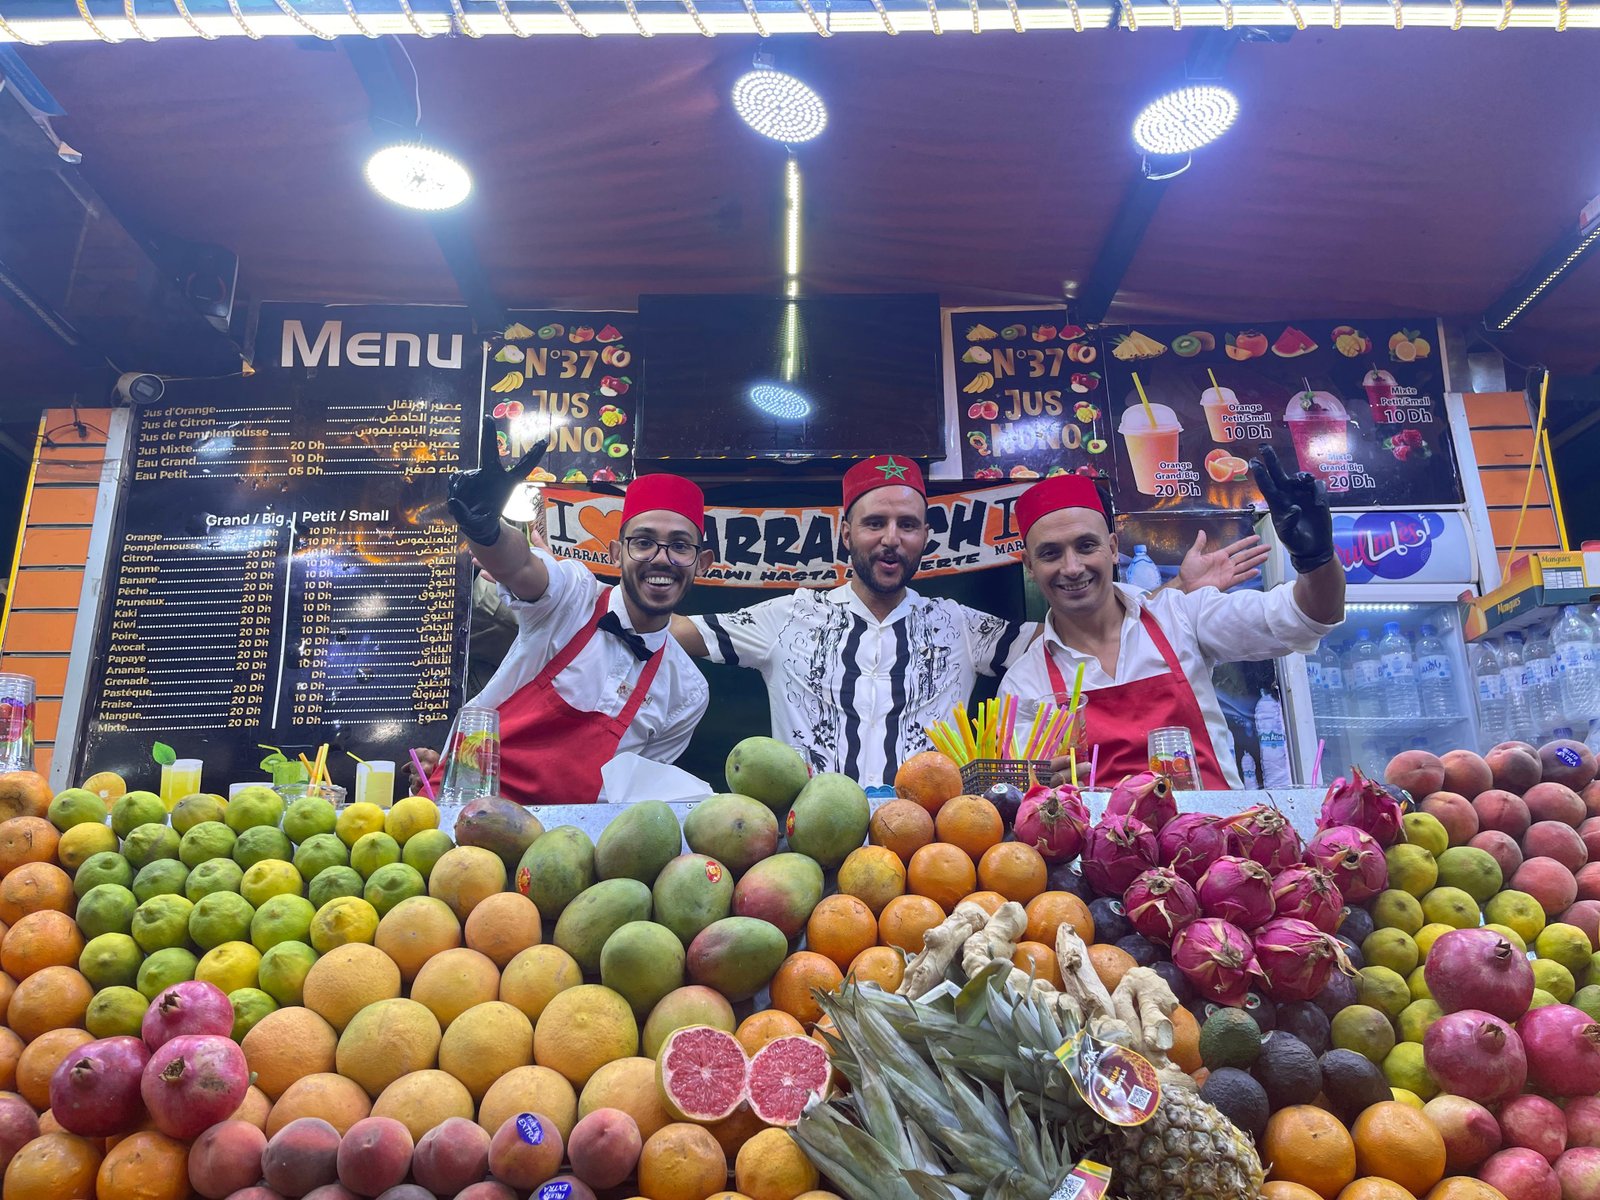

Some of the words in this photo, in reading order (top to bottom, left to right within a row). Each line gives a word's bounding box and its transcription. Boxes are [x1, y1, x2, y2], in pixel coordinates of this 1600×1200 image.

[281, 320, 463, 369] Menu
[1391, 386, 1418, 395] Mixte
[429, 402, 462, 412] عصير
[532, 390, 590, 418] JUS
[1004, 389, 1063, 420] JUS
[1380, 396, 1430, 406] Petit/Small
[143, 408, 162, 418] Jus
[1228, 404, 1262, 413] Orange
[380, 412, 426, 424] الحامض
[428, 414, 461, 424] عصير
[1222, 413, 1272, 422] Petit/Small
[1384, 410, 1405, 424] 10
[1408, 408, 1432, 423] Dh
[141, 421, 160, 430] Jus
[163, 420, 177, 428] de
[428, 426, 460, 436] عصير
[140, 433, 158, 442] Jus
[161, 432, 176, 440] de
[1224, 426, 1244, 440] 10
[1248, 424, 1272, 439] Dh
[138, 446, 158, 456] Jus
[160, 444, 192, 454] Mixte
[290, 442, 306, 450] 20
[308, 440, 325, 450] Dh
[428, 439, 460, 450] عصير
[136, 459, 158, 468] Eau
[160, 456, 196, 466] Grand
[292, 454, 304, 462] 10
[307, 453, 324, 462] Dh
[1159, 461, 1192, 470] Orange
[135, 472, 156, 480] Eau
[159, 469, 188, 480] Petit
[288, 466, 304, 476] 05
[306, 466, 324, 475] Dh
[1319, 462, 1364, 474] Grand/Big
[1154, 471, 1200, 481] Grand/Big
[1329, 475, 1349, 488] 20
[1352, 474, 1376, 488] Dh
[1154, 484, 1174, 497] 20
[1178, 482, 1201, 496] Dh
[206, 513, 250, 526] Grand
[262, 512, 284, 526] Big
[302, 510, 336, 522] Petit
[348, 510, 389, 522] Small
[548, 498, 578, 544] I
[994, 496, 1020, 540] I
[423, 524, 458, 534] البرتقال
[126, 534, 162, 542] Orange
[263, 540, 278, 548] Dh
[396, 536, 458, 546] البامبليموس
[122, 554, 154, 562] Citron
[246, 550, 260, 558] 20
[262, 550, 276, 558] Dh
[416, 546, 456, 556] الحامض
[121, 566, 160, 574] Pomme
[431, 567, 456, 577] الموز
[760, 570, 838, 581] HASTA
[120, 576, 158, 584] Banane
[244, 572, 258, 580] 20
[260, 572, 274, 580] Dh
[428, 578, 456, 590] الخوخ
[243, 584, 256, 592] 20
[258, 582, 273, 591] Dh
[116, 598, 165, 607] Pruneaux
[242, 594, 256, 602] 20
[258, 594, 272, 602] Dh
[304, 592, 315, 600] 10
[318, 592, 332, 600] Dh
[418, 590, 454, 600] البرقوق
[114, 609, 138, 618] Kaki
[240, 606, 255, 614] 20
[256, 605, 272, 613] Dh
[113, 620, 136, 629] Kiwi
[240, 616, 253, 624] 20
[256, 616, 270, 624] Dh
[112, 631, 138, 640] Poire
[239, 628, 252, 636] 20
[255, 628, 270, 636] Dh
[110, 643, 146, 652] Avocat
[238, 640, 252, 648] 20
[254, 638, 268, 646] Dh
[421, 644, 452, 658] الباباي
[108, 654, 146, 664] Papaye
[253, 650, 268, 658] Dh
[106, 666, 146, 674] Ananas
[236, 662, 250, 670] 20
[252, 662, 266, 670] Dh
[422, 667, 450, 678] الرمان
[104, 678, 150, 686] Grenade
[250, 672, 265, 680] Dh
[416, 678, 450, 690] البطيخ
[233, 684, 246, 692] 20
[249, 684, 264, 692] Dh
[412, 690, 449, 700] الفراولة
[101, 700, 132, 709] Fraise
[231, 696, 246, 704] 20
[248, 696, 262, 704] Dh
[100, 712, 142, 722] Mangue
[229, 708, 244, 716] 20
[246, 706, 260, 714] Dh
[418, 712, 448, 724] متنوع
[228, 719, 242, 727] 20
[244, 718, 260, 726] Dh
[518, 1118, 536, 1143] EXTRA
[544, 1184, 568, 1192] EXTRA
